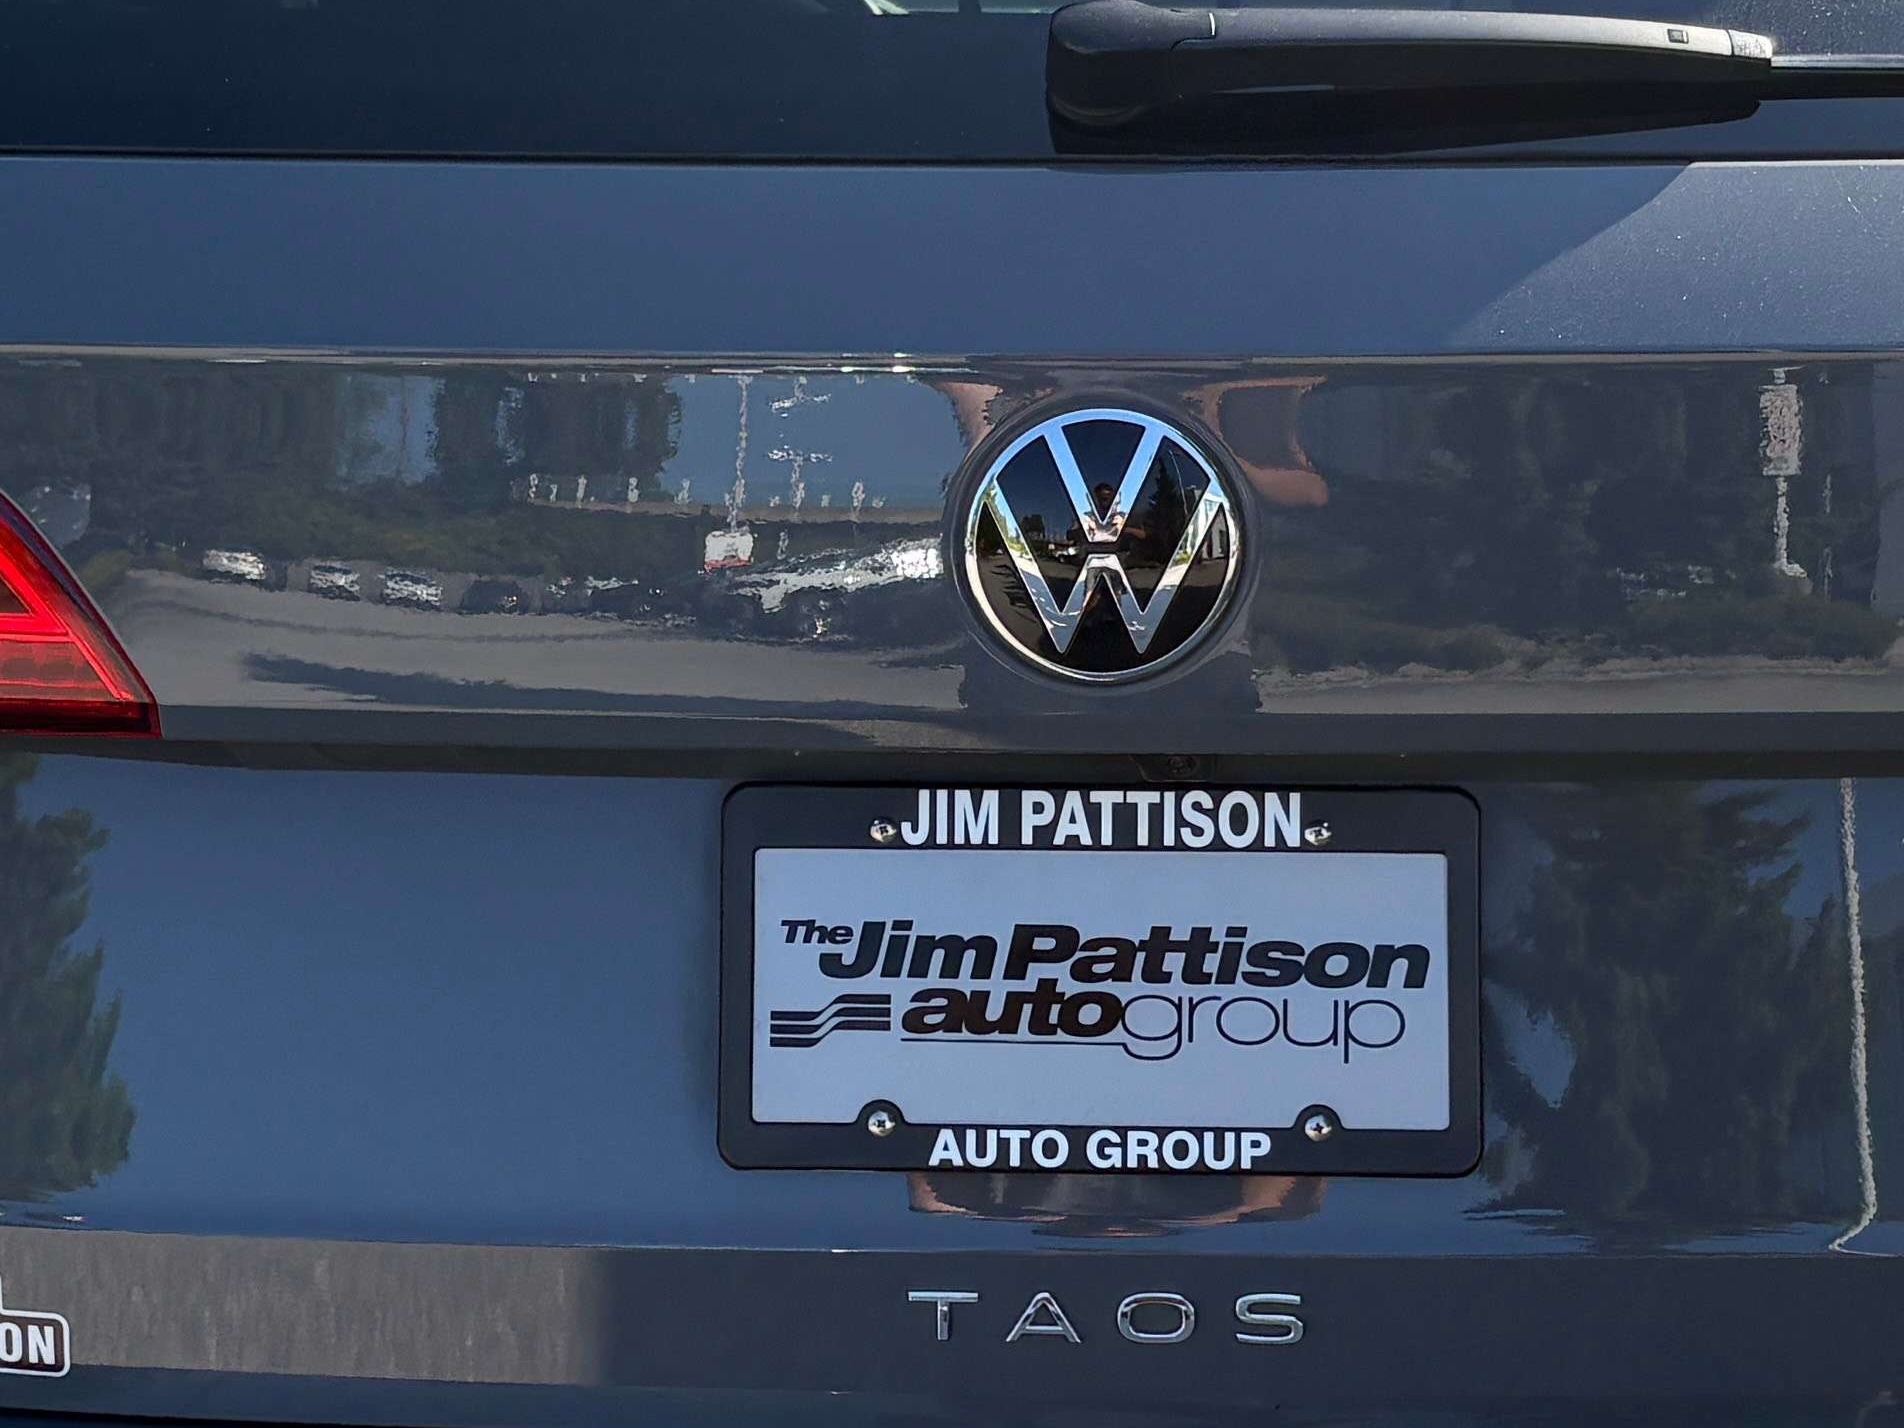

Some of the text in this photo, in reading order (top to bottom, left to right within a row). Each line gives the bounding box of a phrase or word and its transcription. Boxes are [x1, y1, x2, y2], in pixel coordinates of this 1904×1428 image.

[964, 408, 1240, 681] VW
[900, 789, 1302, 848] JIM PATTISON
[781, 919, 1431, 990] The Jim Pattison
[928, 1129, 1272, 1172] AUTO GROUP
[907, 1290, 1304, 1345] TAOS
